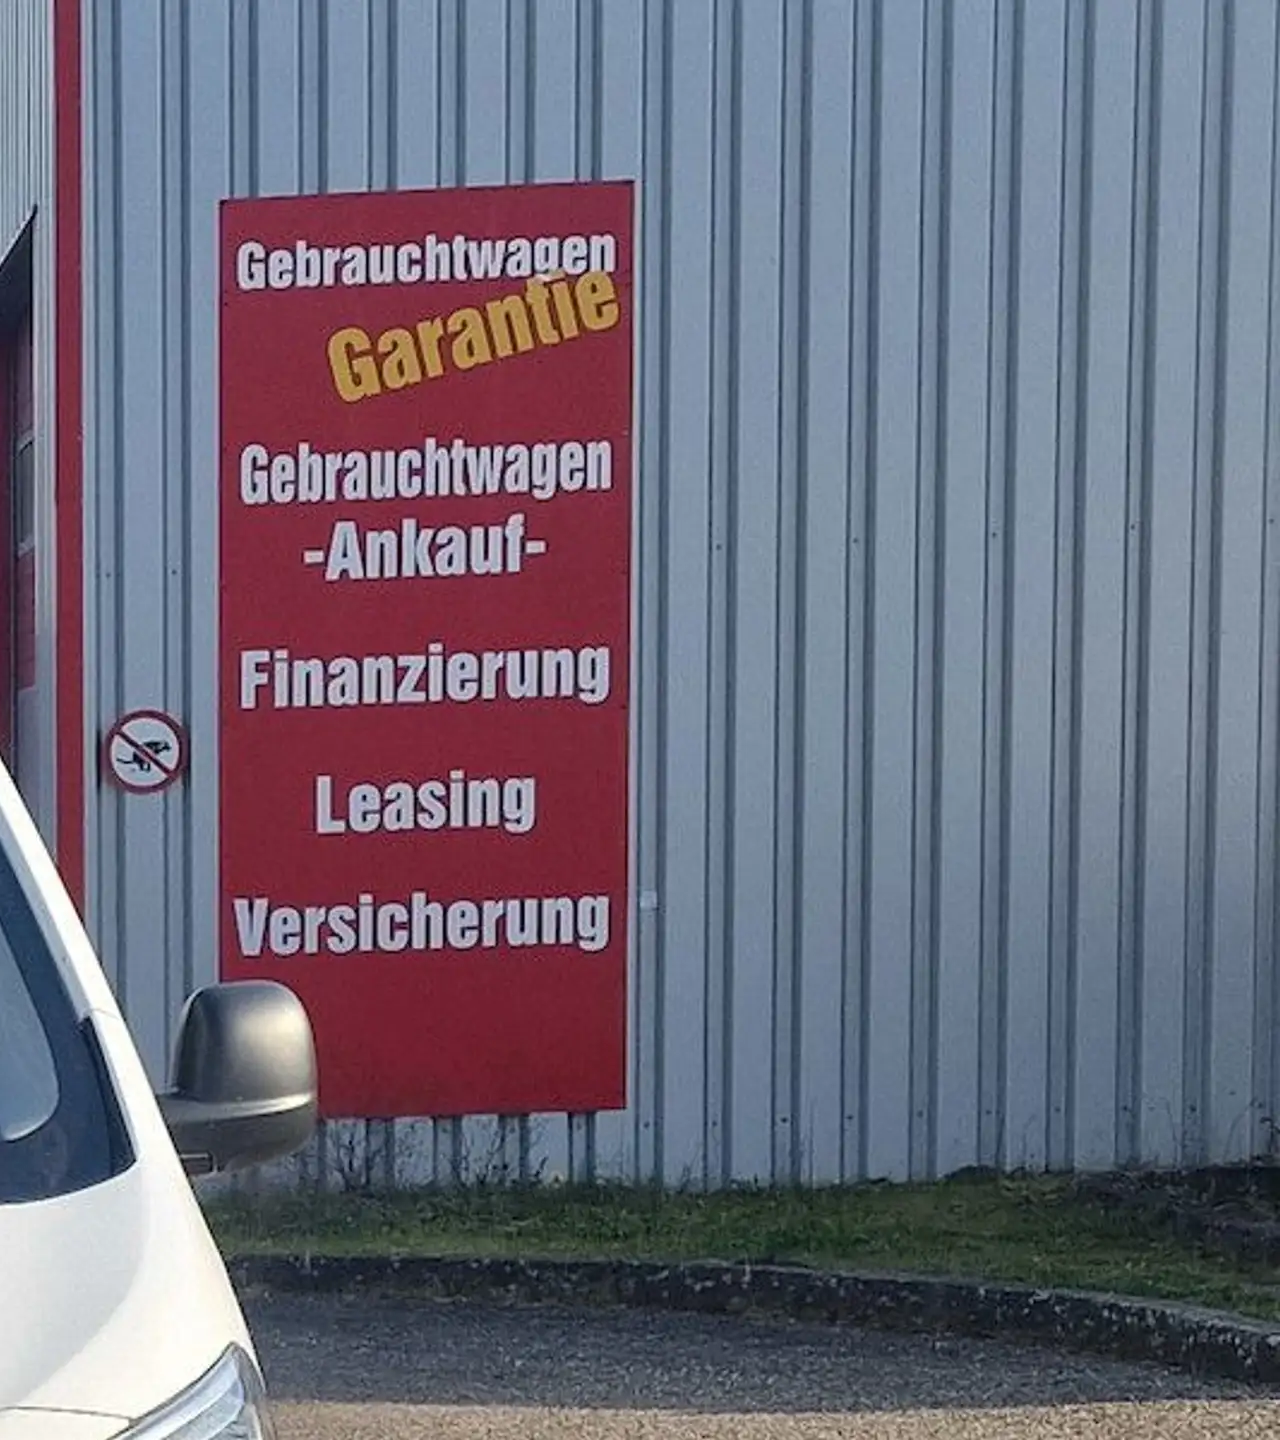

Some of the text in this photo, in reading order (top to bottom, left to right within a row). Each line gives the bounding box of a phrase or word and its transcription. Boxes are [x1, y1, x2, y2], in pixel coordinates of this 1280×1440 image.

[237, 232, 616, 291] Gebrauchtwagen
[326, 268, 621, 403] Garantie
[240, 437, 612, 505] Gebrauchtwagen
[303, 513, 547, 582] -Ankauf-
[241, 642, 610, 709] Finanzierung
[316, 769, 536, 834] Leasing
[233, 892, 610, 957] Versicherung
